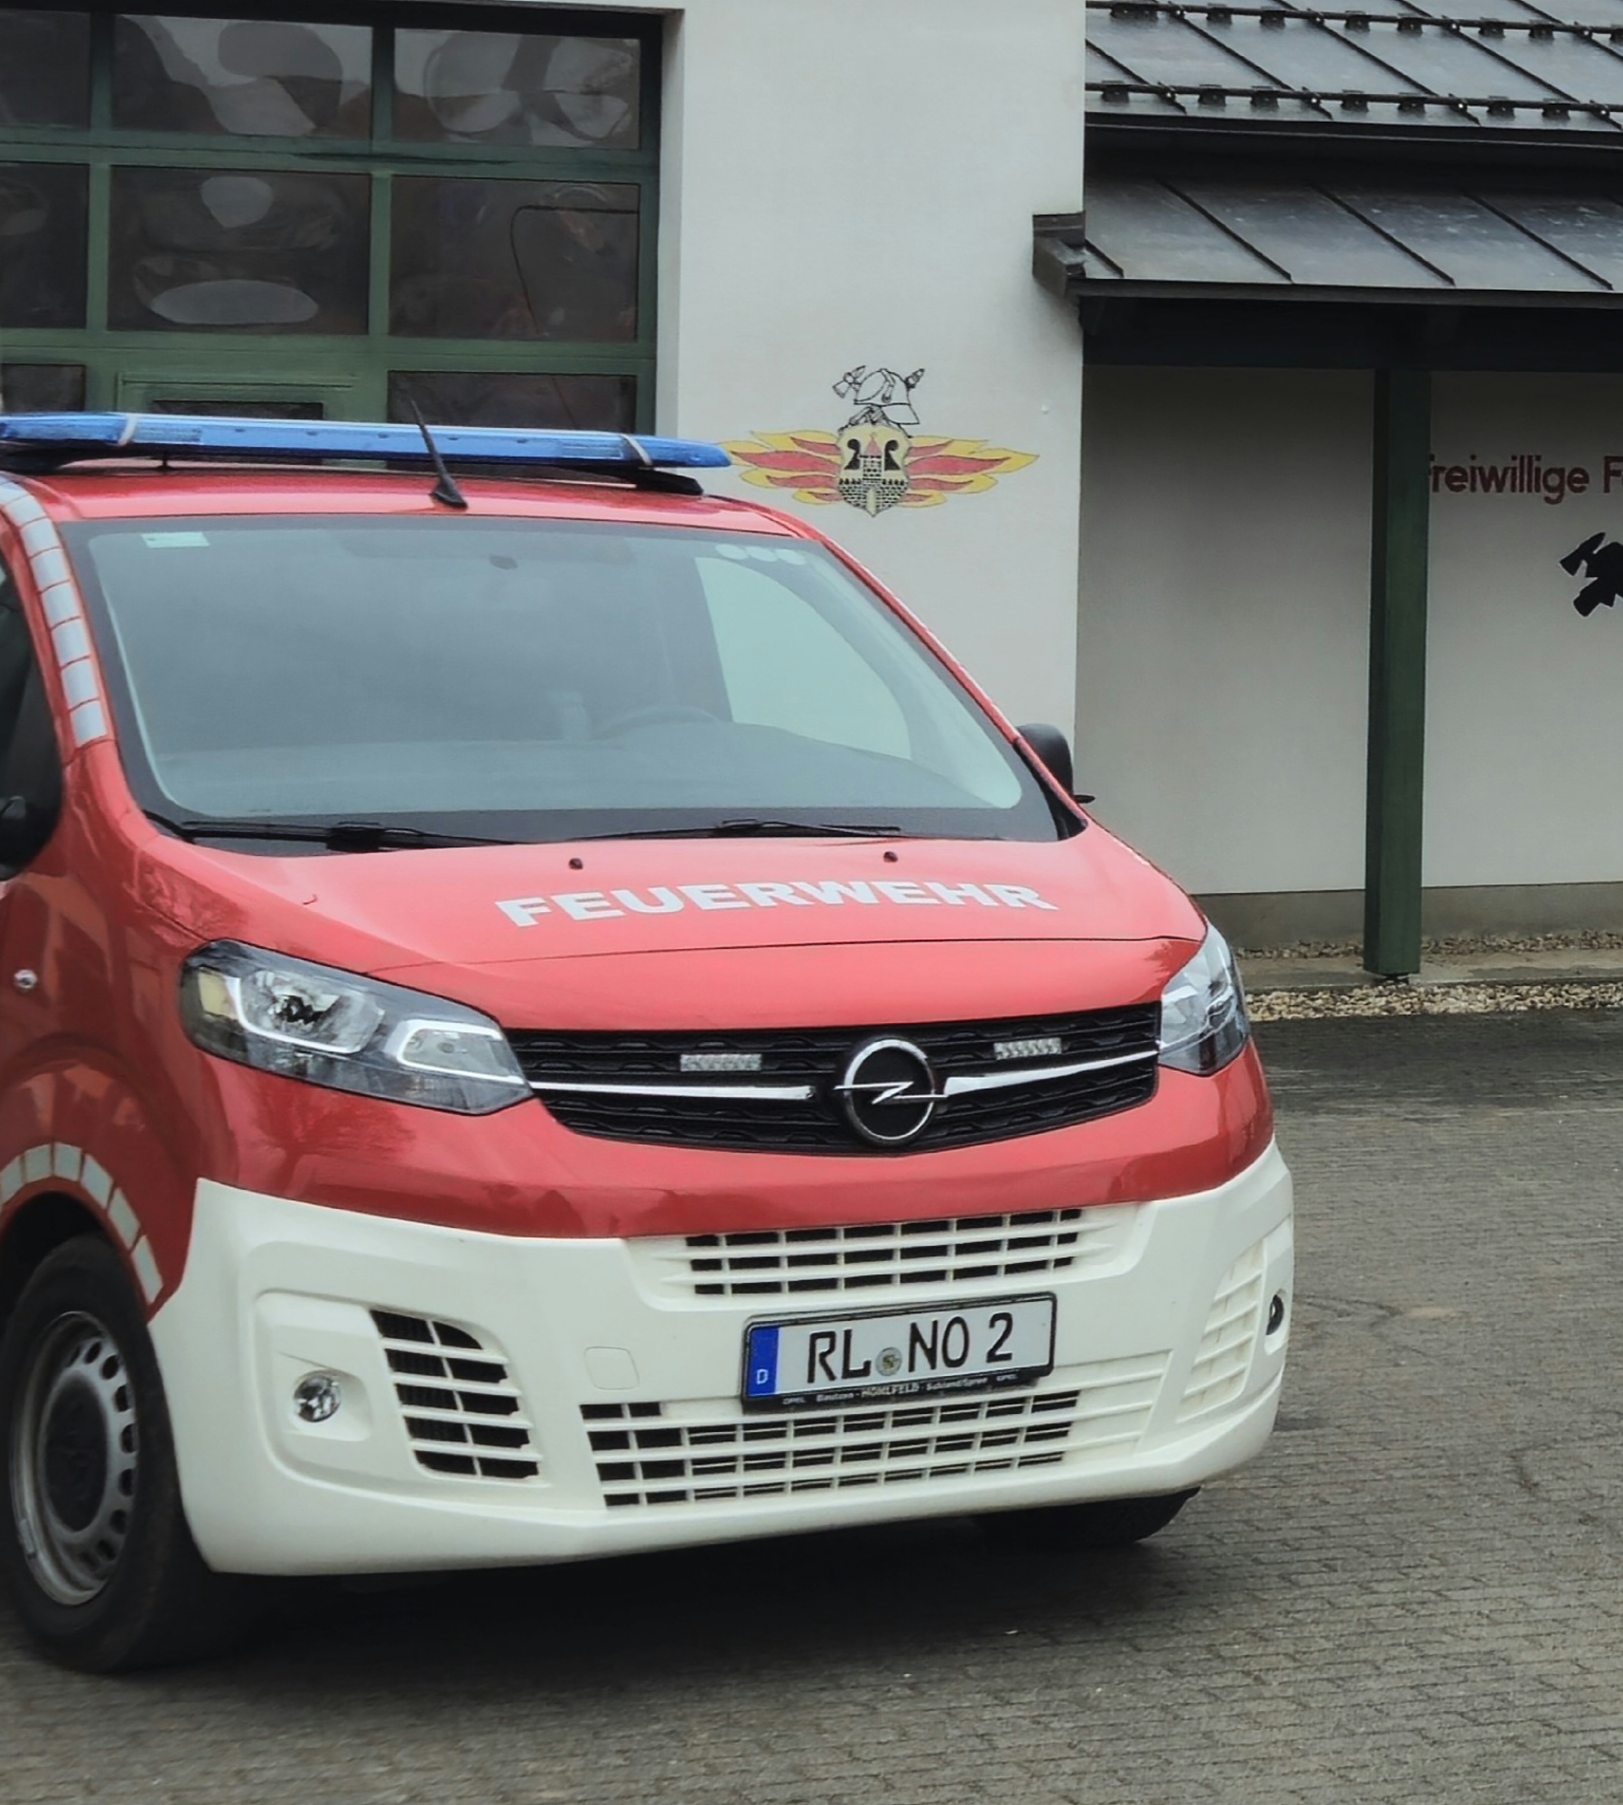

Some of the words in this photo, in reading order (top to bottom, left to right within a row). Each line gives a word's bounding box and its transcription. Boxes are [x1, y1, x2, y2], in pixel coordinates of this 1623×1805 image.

[1428, 454, 1590, 505] reiwillige
[494, 881, 1059, 927] FEUERWEHR
[807, 1329, 871, 1383] RL
[908, 1315, 969, 1372] NO
[985, 1312, 1013, 1363] 2
[756, 1368, 768, 1385] D
